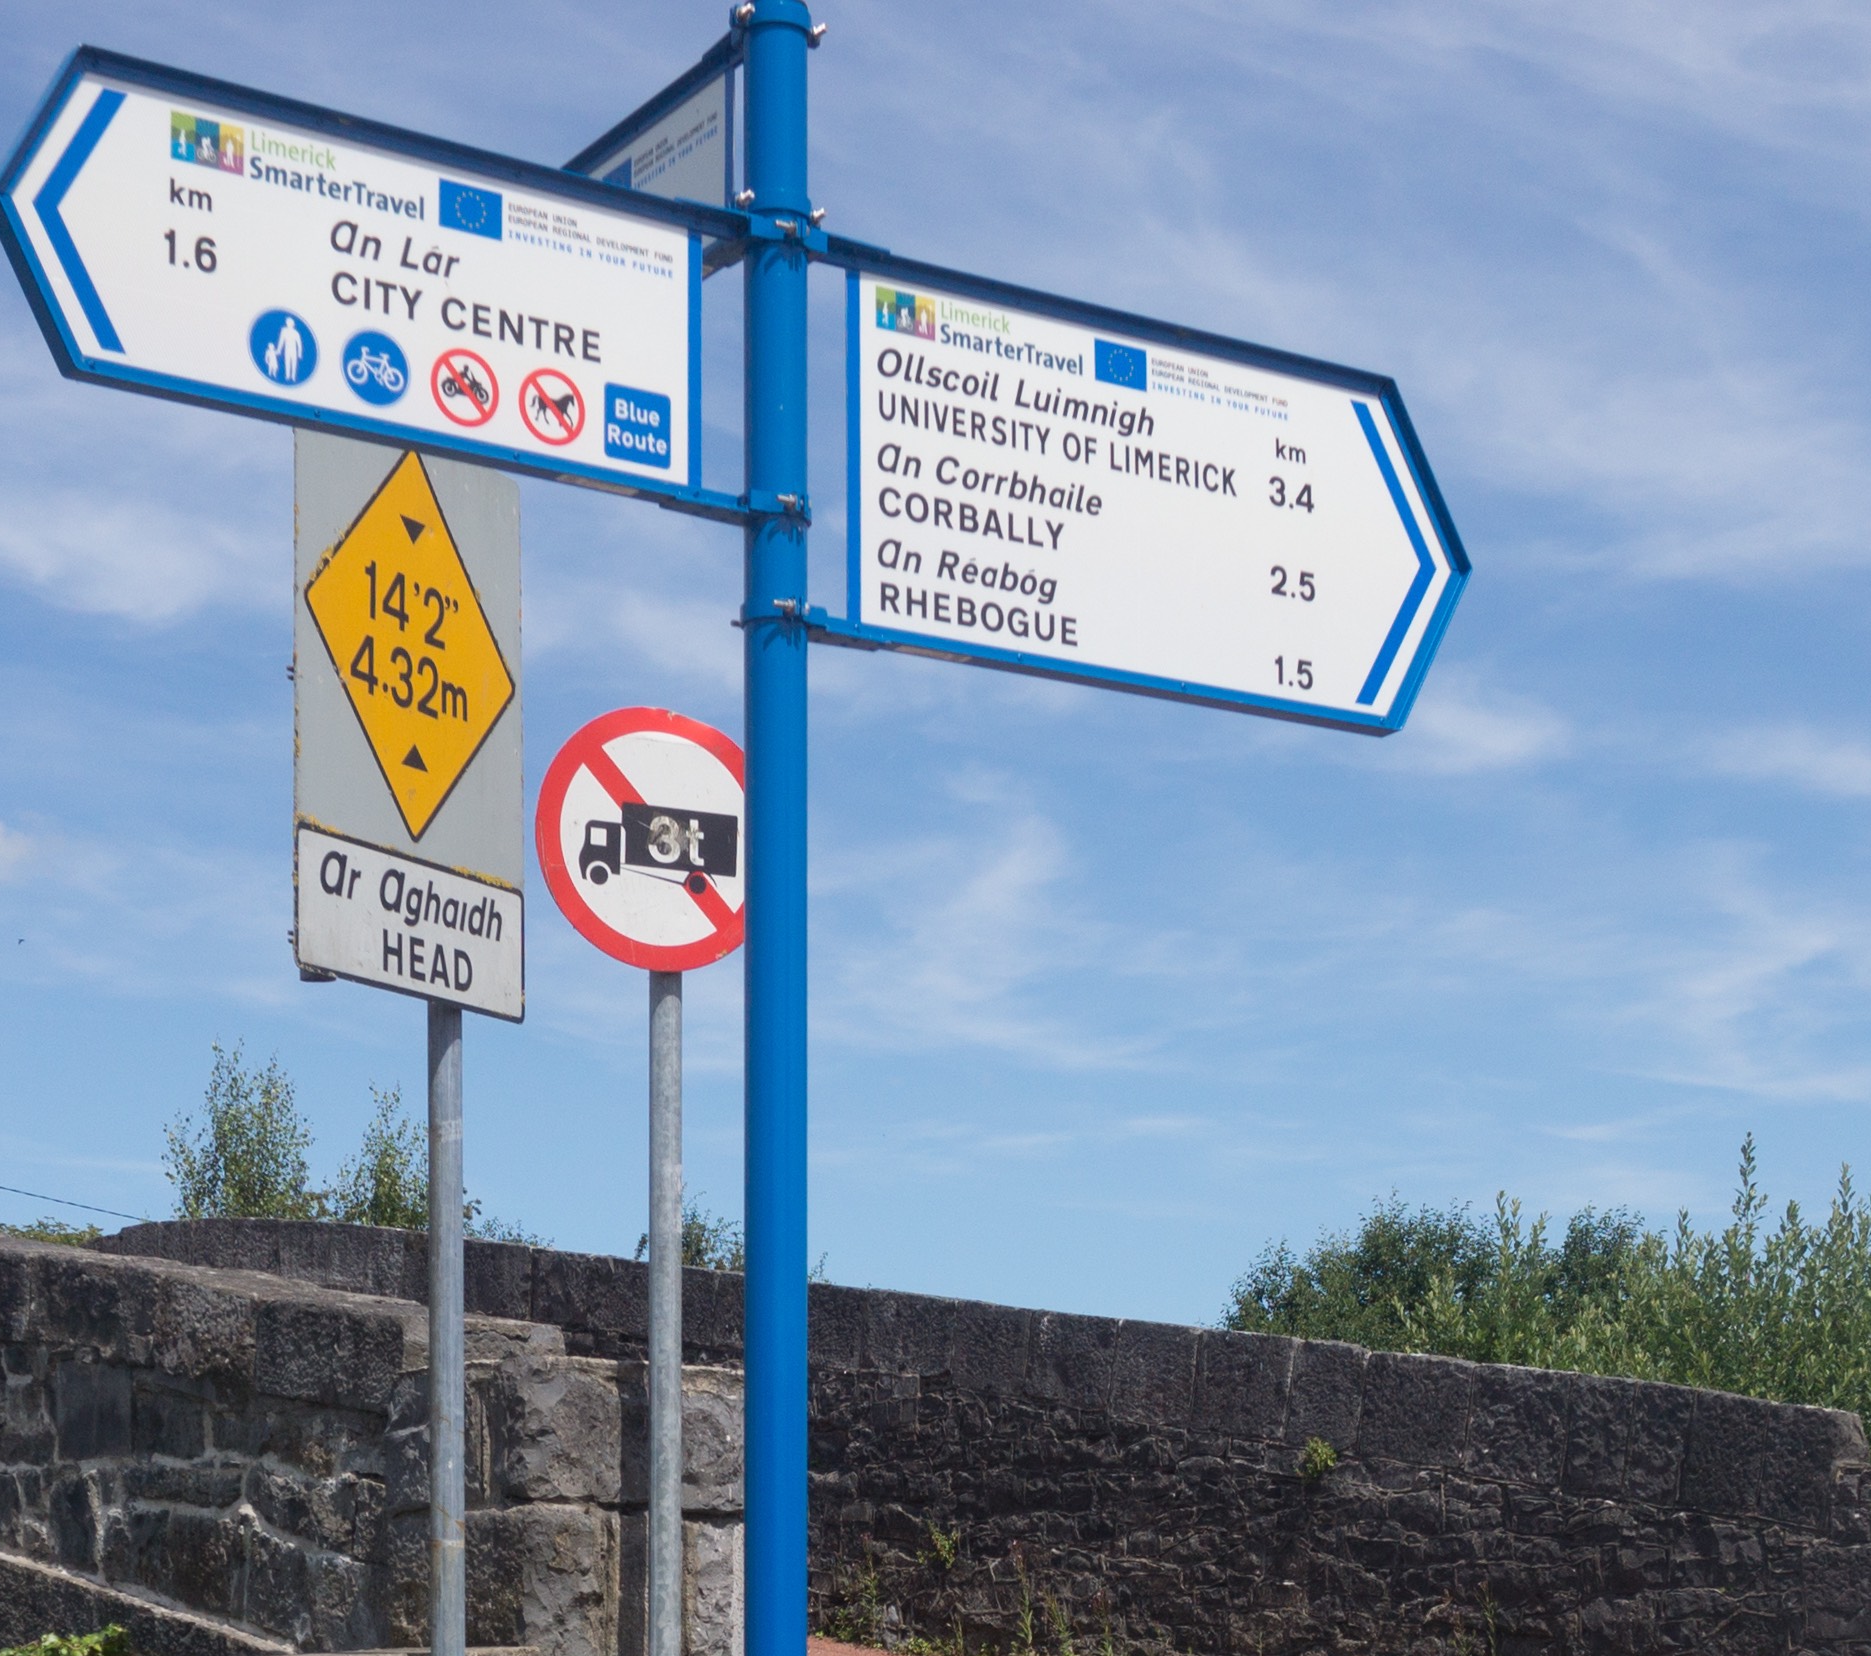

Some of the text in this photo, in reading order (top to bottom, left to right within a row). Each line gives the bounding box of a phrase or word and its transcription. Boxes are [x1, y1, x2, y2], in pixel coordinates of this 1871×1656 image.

[251, 130, 337, 172] Limerick
[169, 176, 213, 213] km
[250, 156, 425, 221] SmarterTravel
[508, 202, 578, 228] EUROPEAN UNION
[508, 214, 674, 263] EUROPEAN REGIONAL DEVELOPMENT FUND
[164, 229, 218, 274] 1.6
[508, 229, 674, 279] INVESTING IN YOUR FUTURE
[331, 270, 601, 364] CITY CENTRE
[940, 301, 1011, 335] Limerick
[939, 323, 1084, 376] SmarterTravel
[1151, 357, 1209, 379] EUROPEAN UNION
[615, 397, 661, 428] Blue
[877, 348, 1155, 437] Ollscoil Luimnigh
[1151, 368, 1185, 383] EUROPEAN
[1224, 386, 1268, 404] DEVELOPMENT
[1272, 396, 1289, 408] FUND
[1152, 381, 1289, 421] INVESTING IN YOUR FUTURE
[607, 422, 668, 457] Route
[878, 390, 1316, 514] UNIVERSITY OF LIMERICK 3.4
[1275, 436, 1306, 466] km
[935, 456, 1104, 517] Corrbhaile
[878, 486, 1317, 602] CORBALLY 2.5
[880, 581, 1315, 691] RHEBOGUE 1.5
[349, 634, 469, 724] 4.32m
[648, 815, 705, 867] 3t
[383, 928, 474, 993] HEAD
